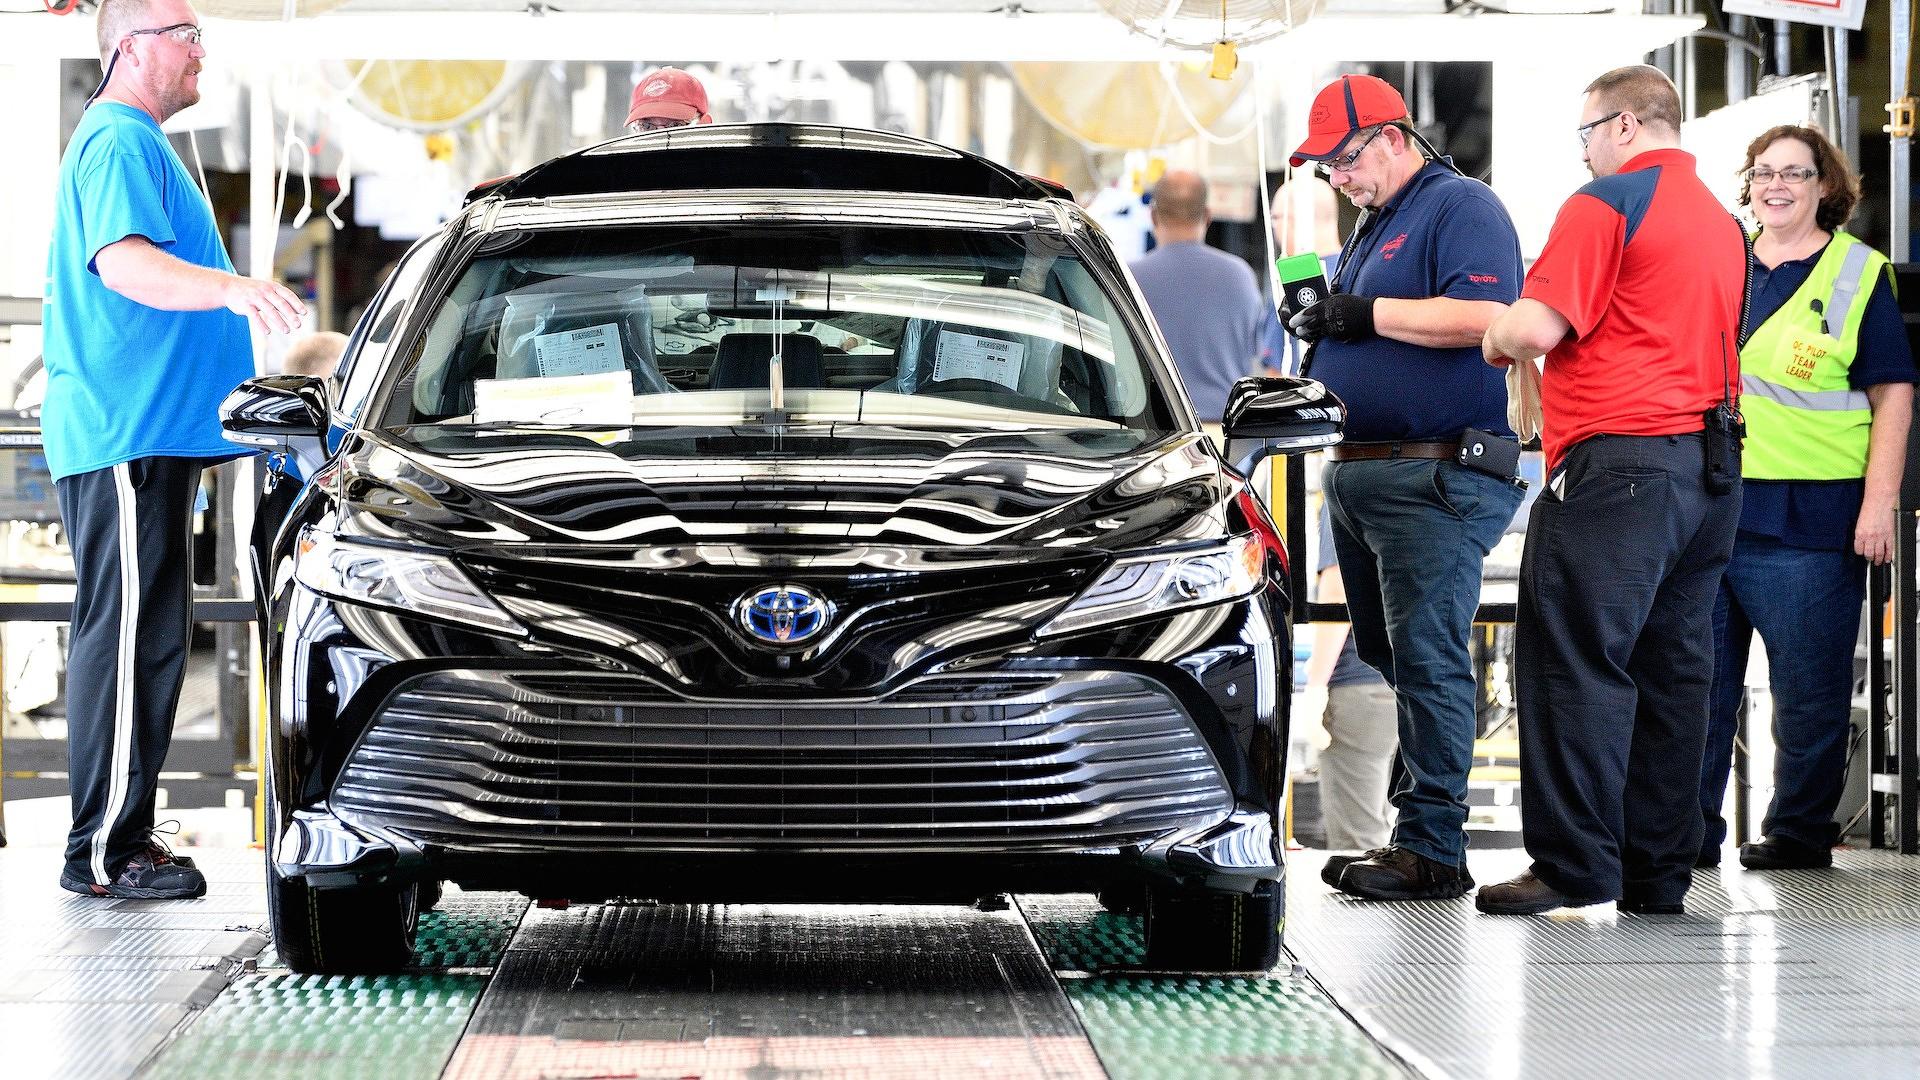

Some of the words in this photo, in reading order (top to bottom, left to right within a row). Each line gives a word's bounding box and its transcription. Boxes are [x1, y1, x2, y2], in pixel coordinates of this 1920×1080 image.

[1469, 274, 1498, 284] TOYOTA
[1806, 345, 1826, 358] PILOT
[1793, 354, 1816, 370] TEAM
[1786, 365, 1812, 381] LEADER
